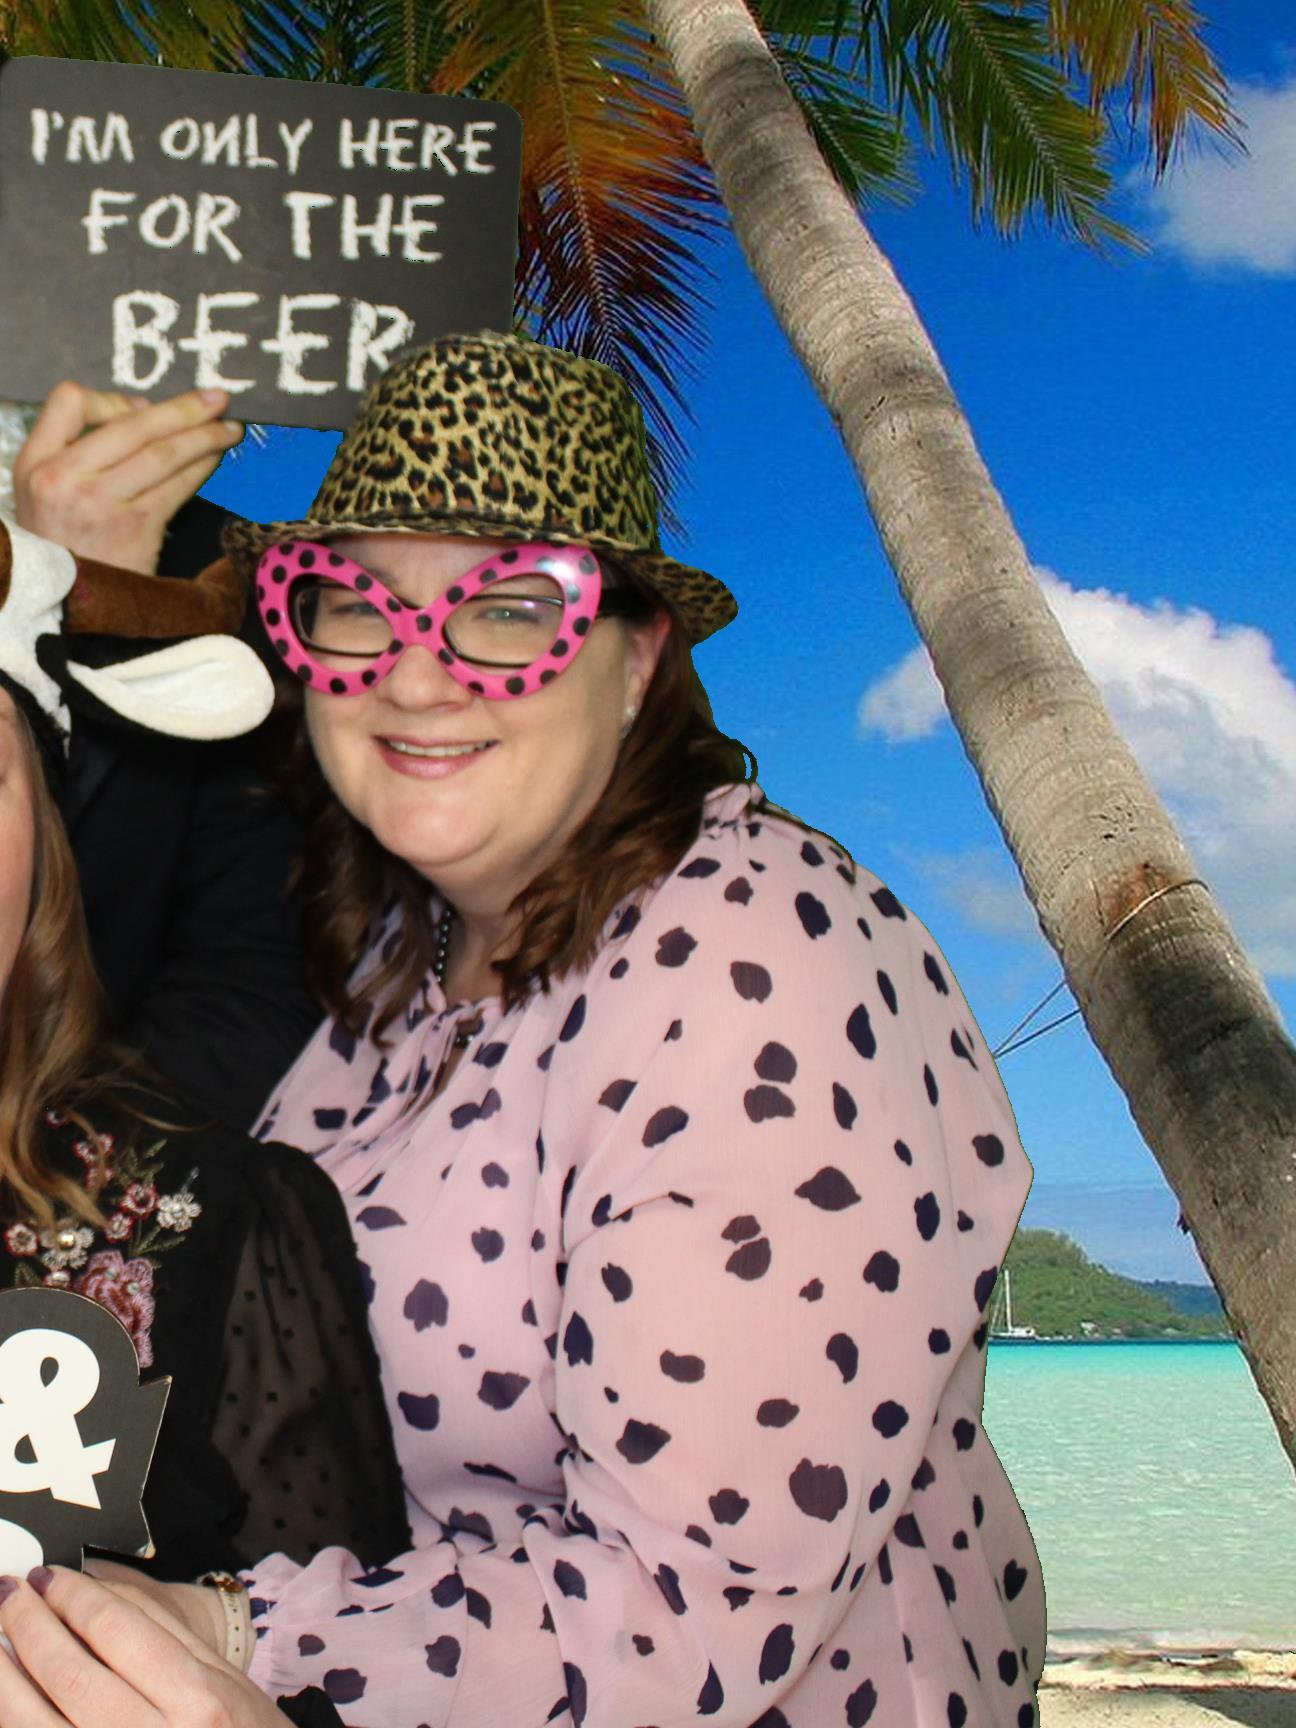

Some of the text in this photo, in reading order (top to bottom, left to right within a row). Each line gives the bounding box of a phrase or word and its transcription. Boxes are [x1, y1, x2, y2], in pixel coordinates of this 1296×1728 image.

[30, 108, 497, 176] I'M ONLY HERE
[82, 188, 446, 264] FOR THE
[112, 290, 415, 395] BEER
